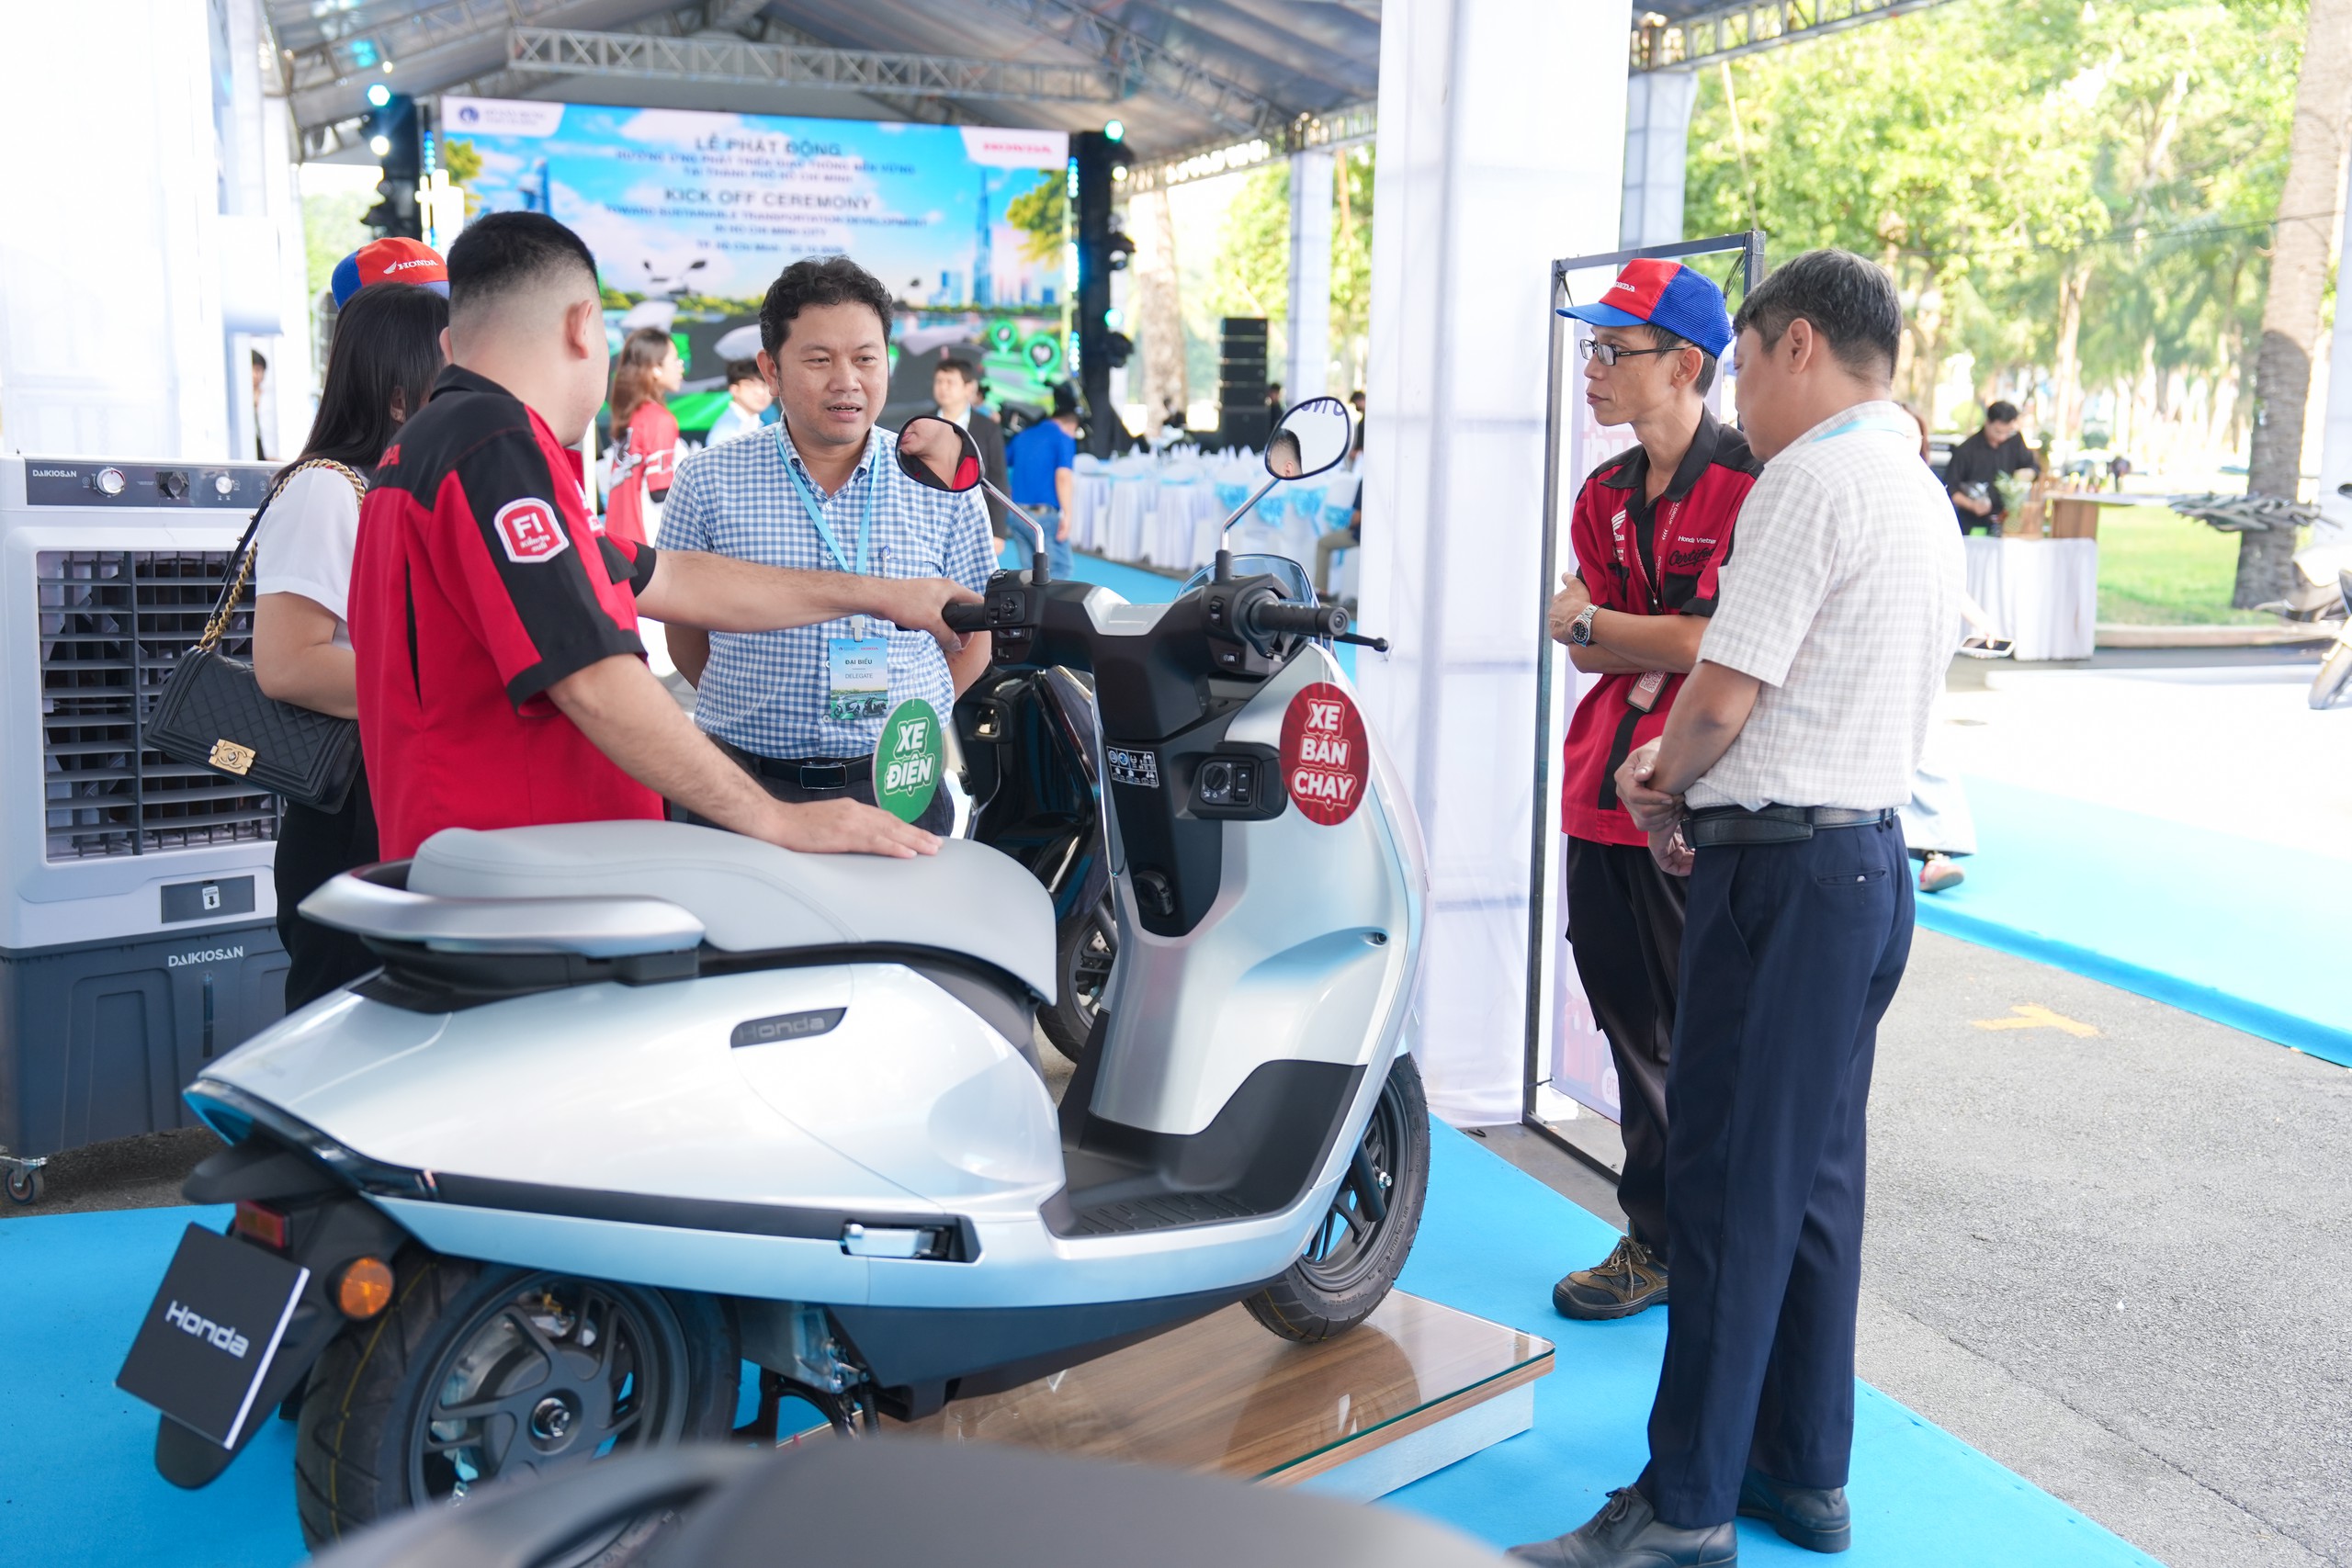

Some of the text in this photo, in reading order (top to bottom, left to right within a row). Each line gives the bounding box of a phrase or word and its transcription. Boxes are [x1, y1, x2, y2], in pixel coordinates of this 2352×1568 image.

[664, 186, 873, 211] KICK OFF CEREMONY
[846, 216, 928, 229] DEVELOPMENT
[397, 258, 439, 270] HONDA
[32, 469, 77, 478] DAIKIOSAN
[1678, 536, 1695, 544] Honda
[1307, 704, 1340, 731] XE
[897, 722, 924, 753] XE
[1301, 735, 1348, 766] BÁN
[887, 753, 933, 793] ĐIỆN
[1294, 771, 1353, 805] CHẠY
[168, 946, 243, 967] DAIKIOSAN
[739, 1017, 825, 1042] Honda
[165, 1299, 250, 1359] Honda
